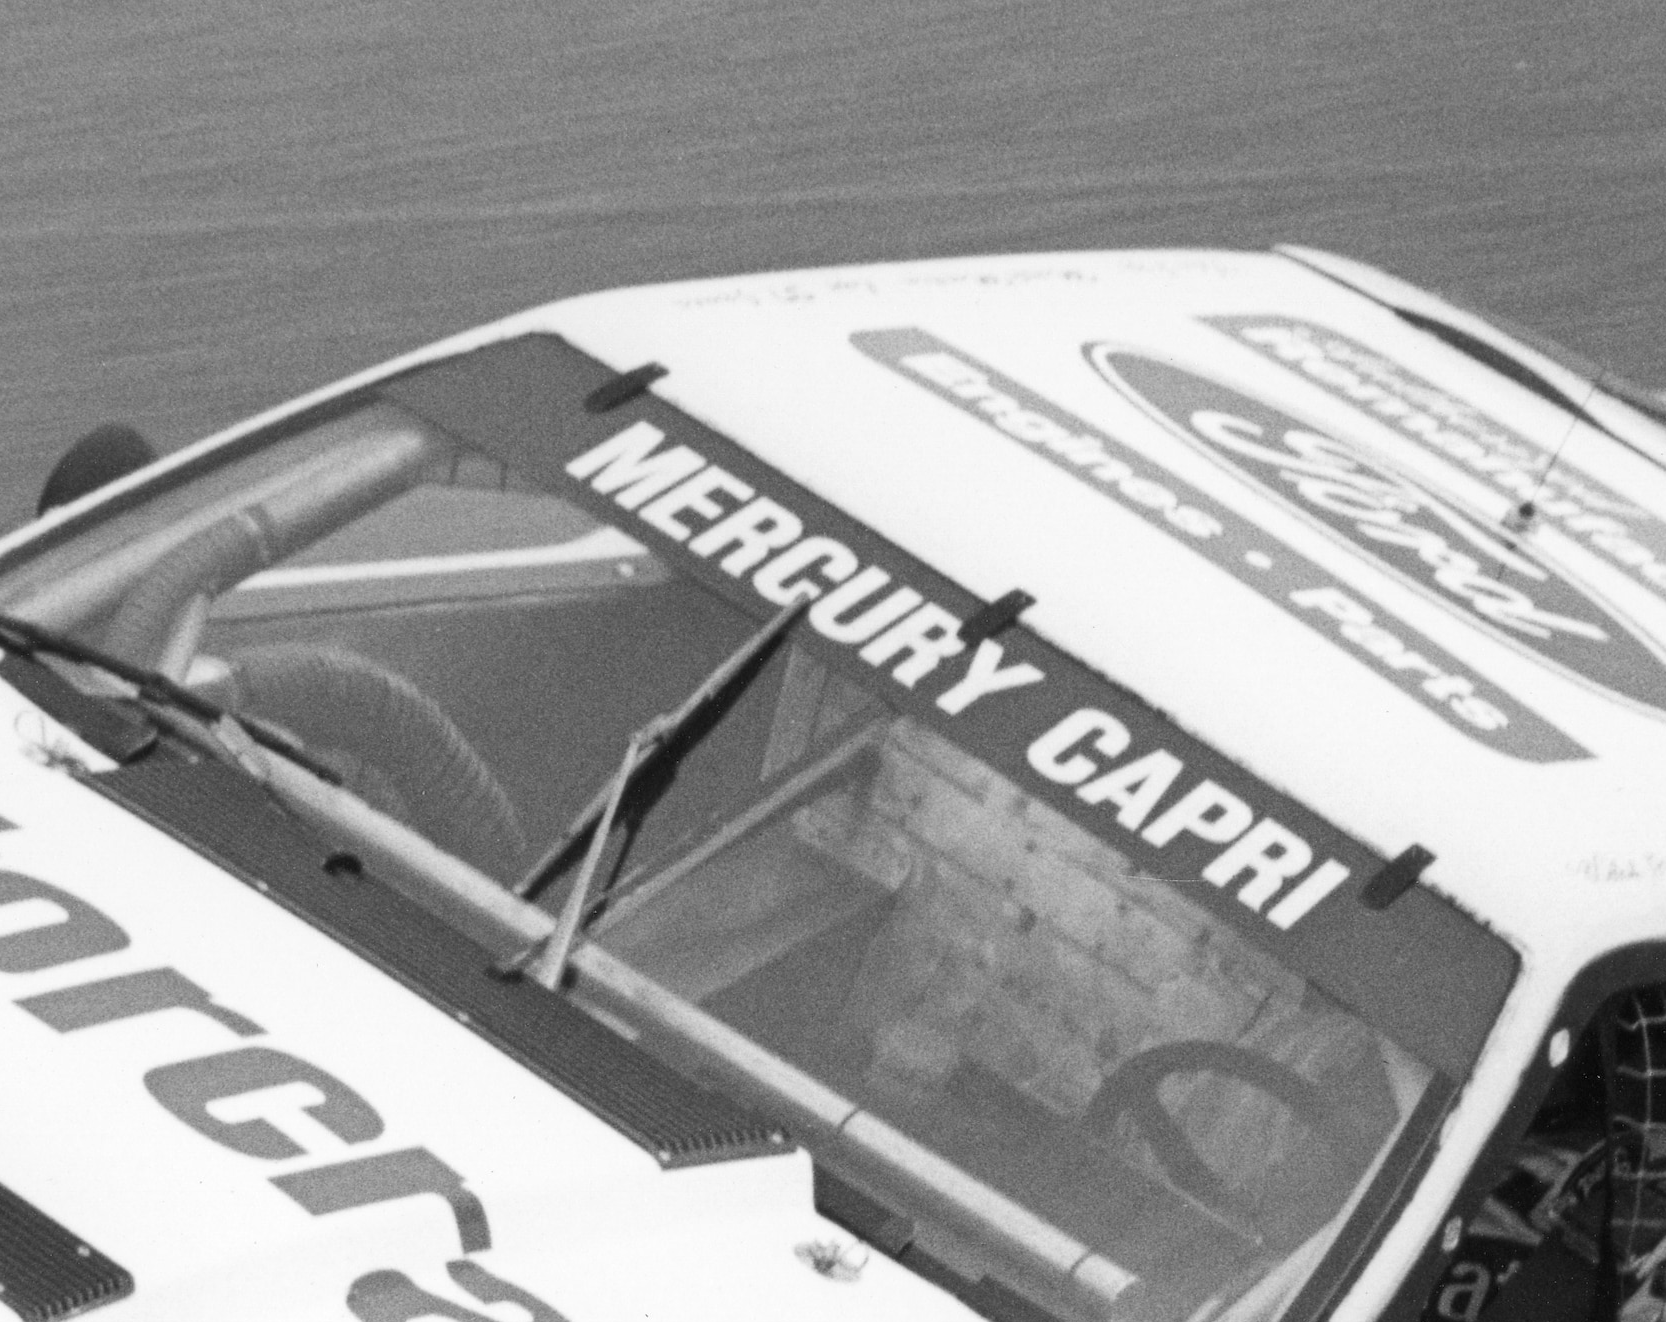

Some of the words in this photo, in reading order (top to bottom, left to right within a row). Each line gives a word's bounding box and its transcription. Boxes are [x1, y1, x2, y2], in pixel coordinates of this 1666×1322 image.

[565, 420, 1044, 716] MERCURY
[1026, 707, 1351, 931] CAPRI
[899, 352, 1223, 538] Engines
[1288, 588, 1509, 730] Parts
[1190, 411, 1609, 641] Ford
